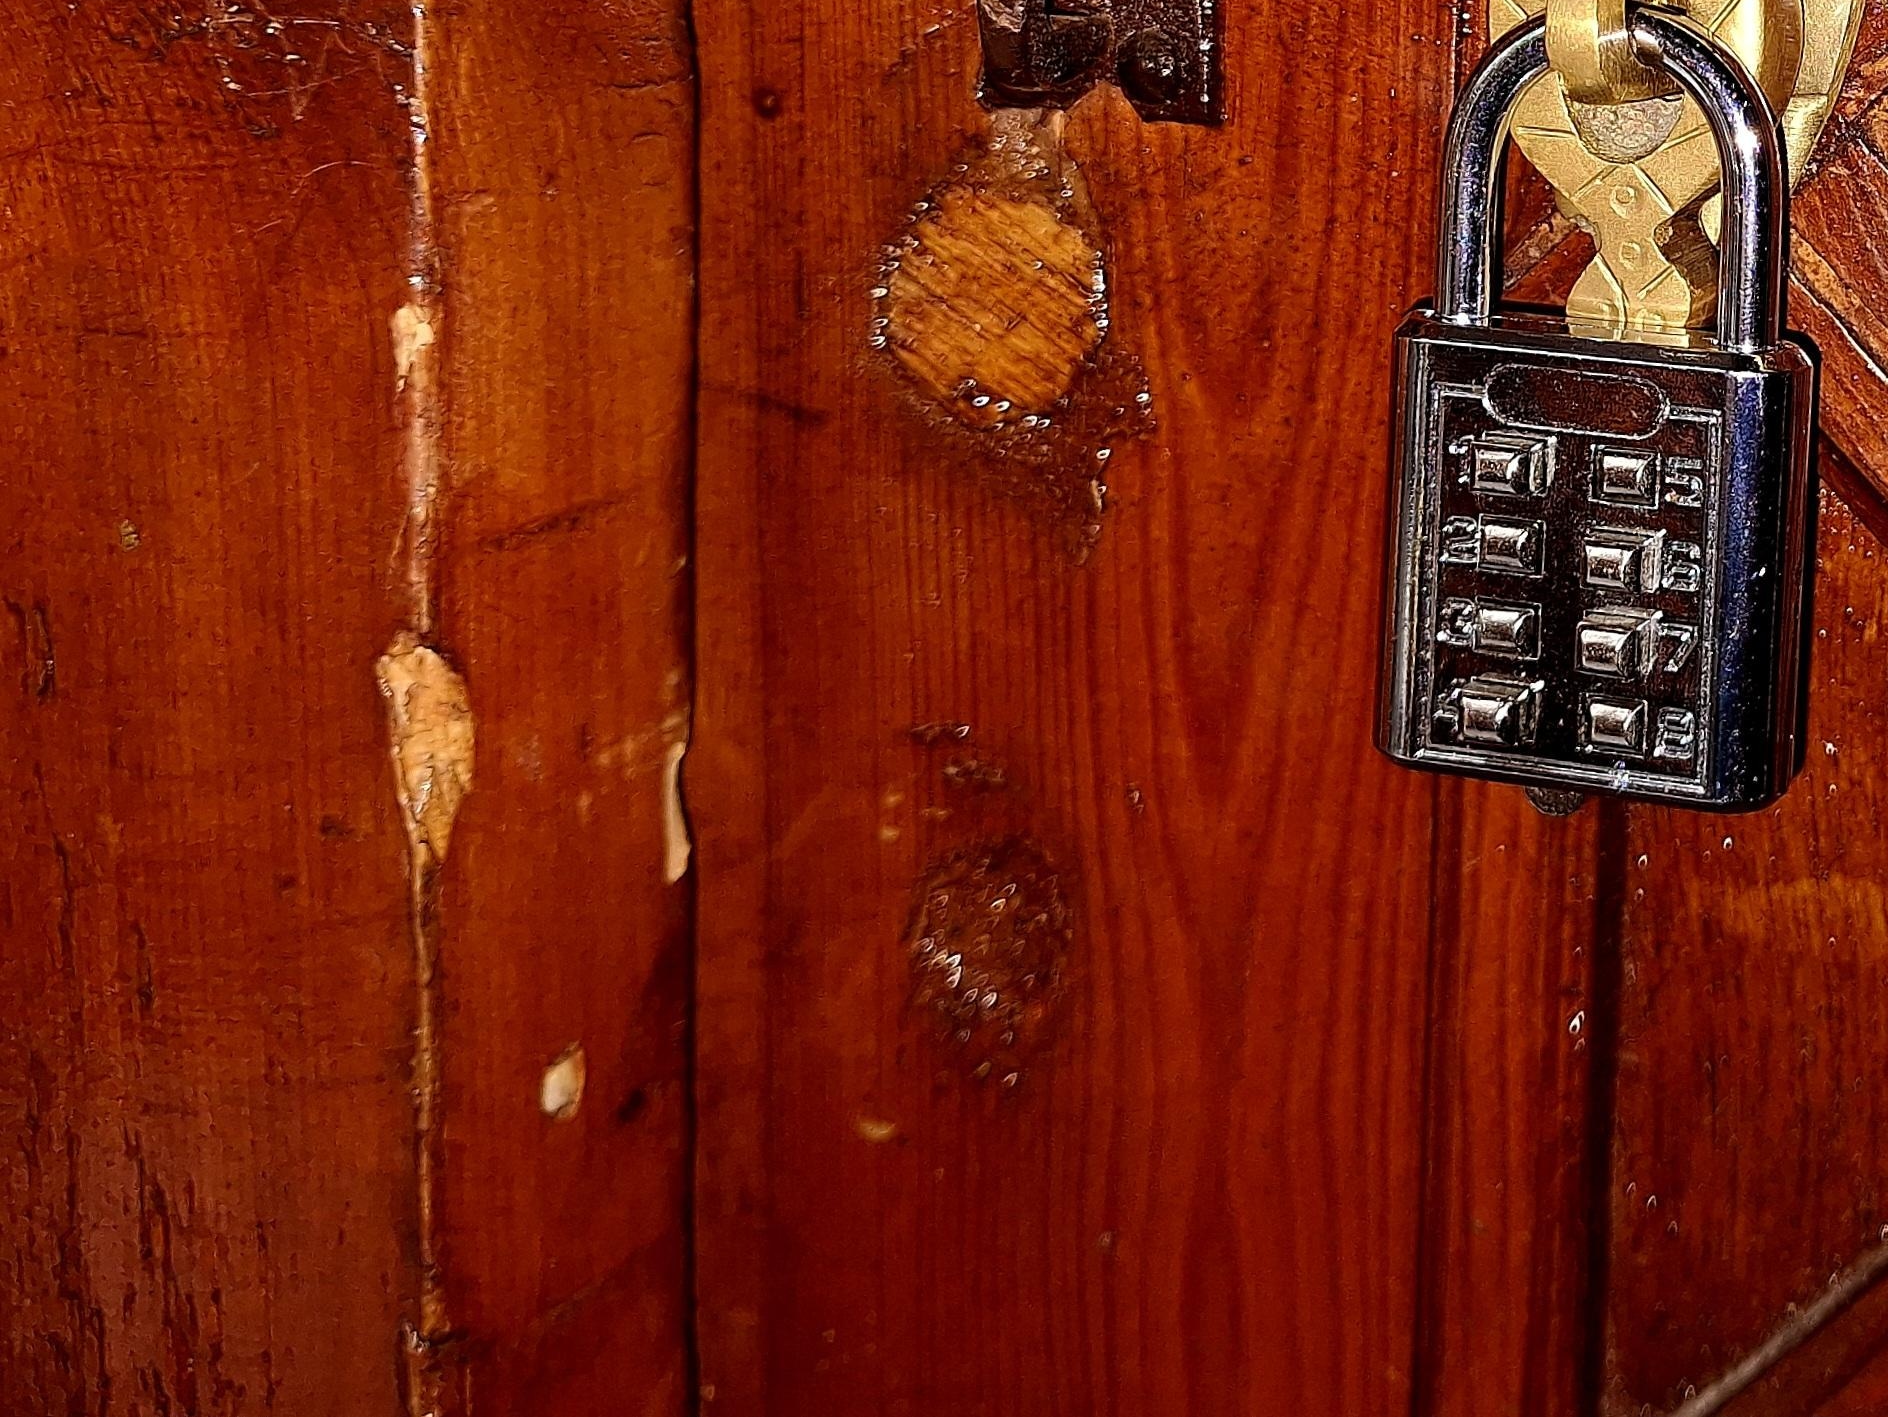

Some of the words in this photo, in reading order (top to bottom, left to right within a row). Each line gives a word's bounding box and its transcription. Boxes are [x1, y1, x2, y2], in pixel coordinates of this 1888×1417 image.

[1665, 456, 1703, 507] 5
[1440, 516, 1478, 564] 2
[1662, 540, 1701, 592] 6
[1436, 597, 1475, 646] 3
[1660, 622, 1699, 672] 7
